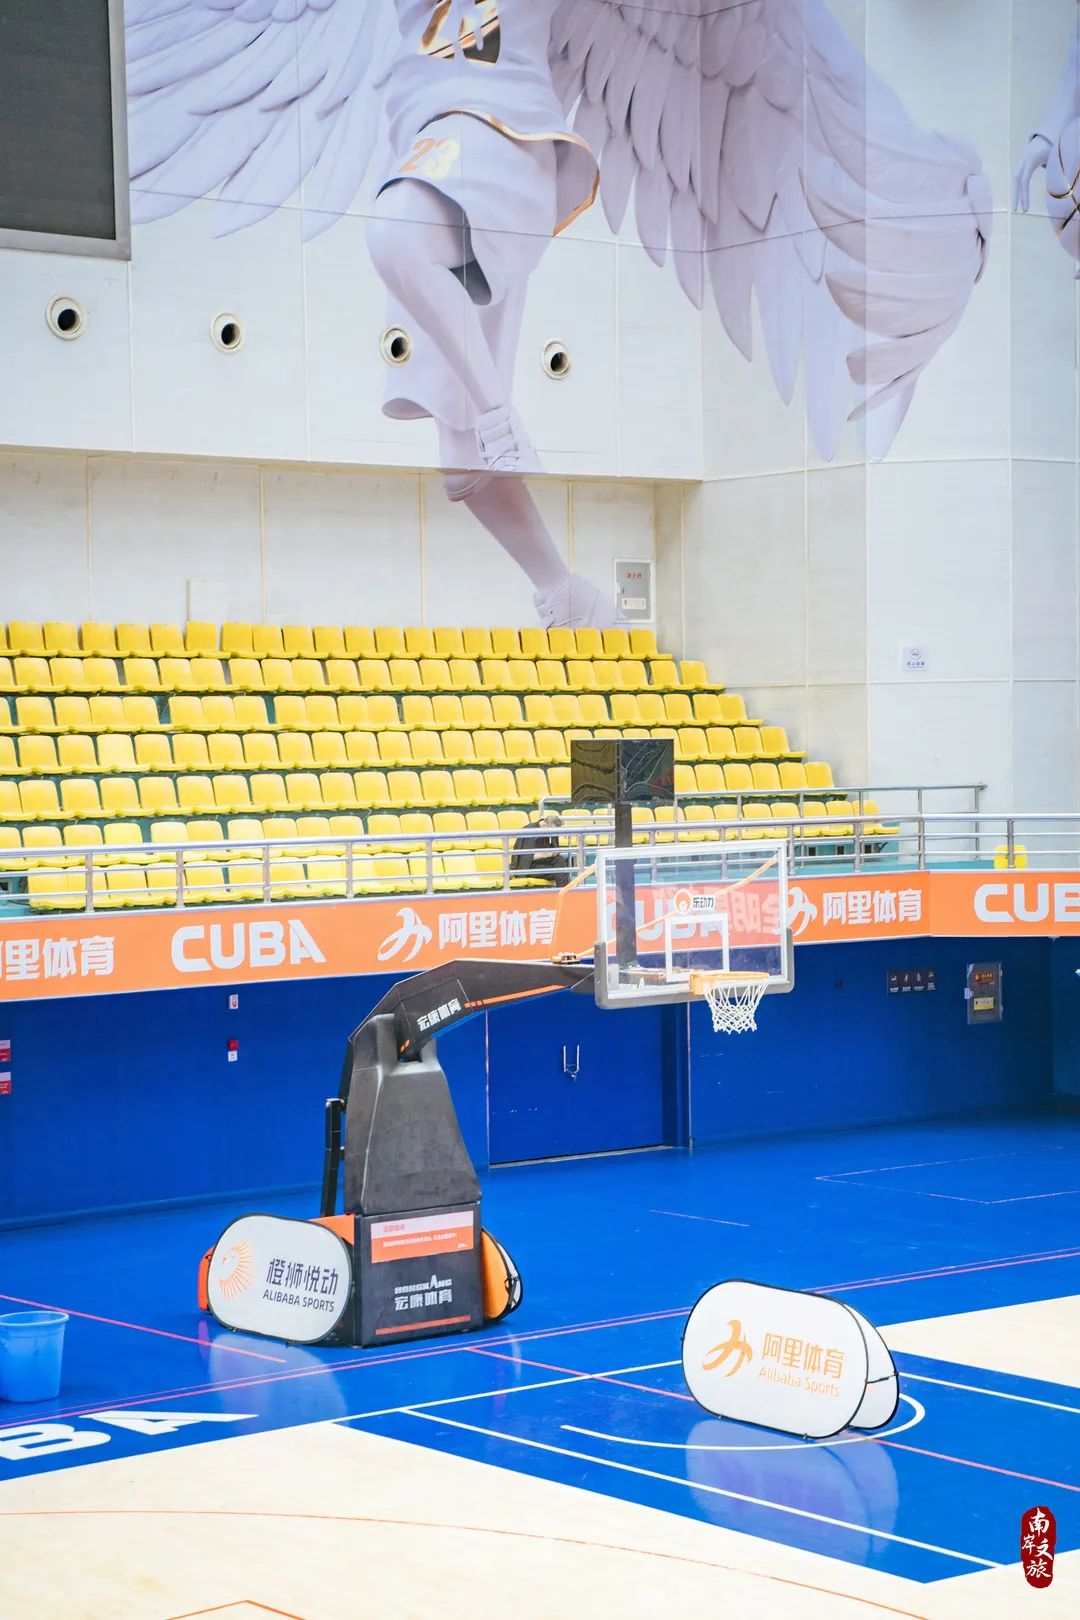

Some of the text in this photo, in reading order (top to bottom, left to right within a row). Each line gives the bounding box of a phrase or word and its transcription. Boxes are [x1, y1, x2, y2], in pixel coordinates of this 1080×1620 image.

[398, 138, 461, 181] 23
[822, 888, 922, 927] 阿里体育
[171, 919, 327, 973] CUBA
[438, 908, 557, 950] 阿里体育
[0, 935, 115, 981] 里体育
[266, 1258, 339, 1295] 橙狮悦动
[262, 1288, 335, 1313] ALIBABA SPORTS
[762, 1332, 845, 1379] 阿里体育
[759, 1366, 840, 1397] Alibaba Sports
